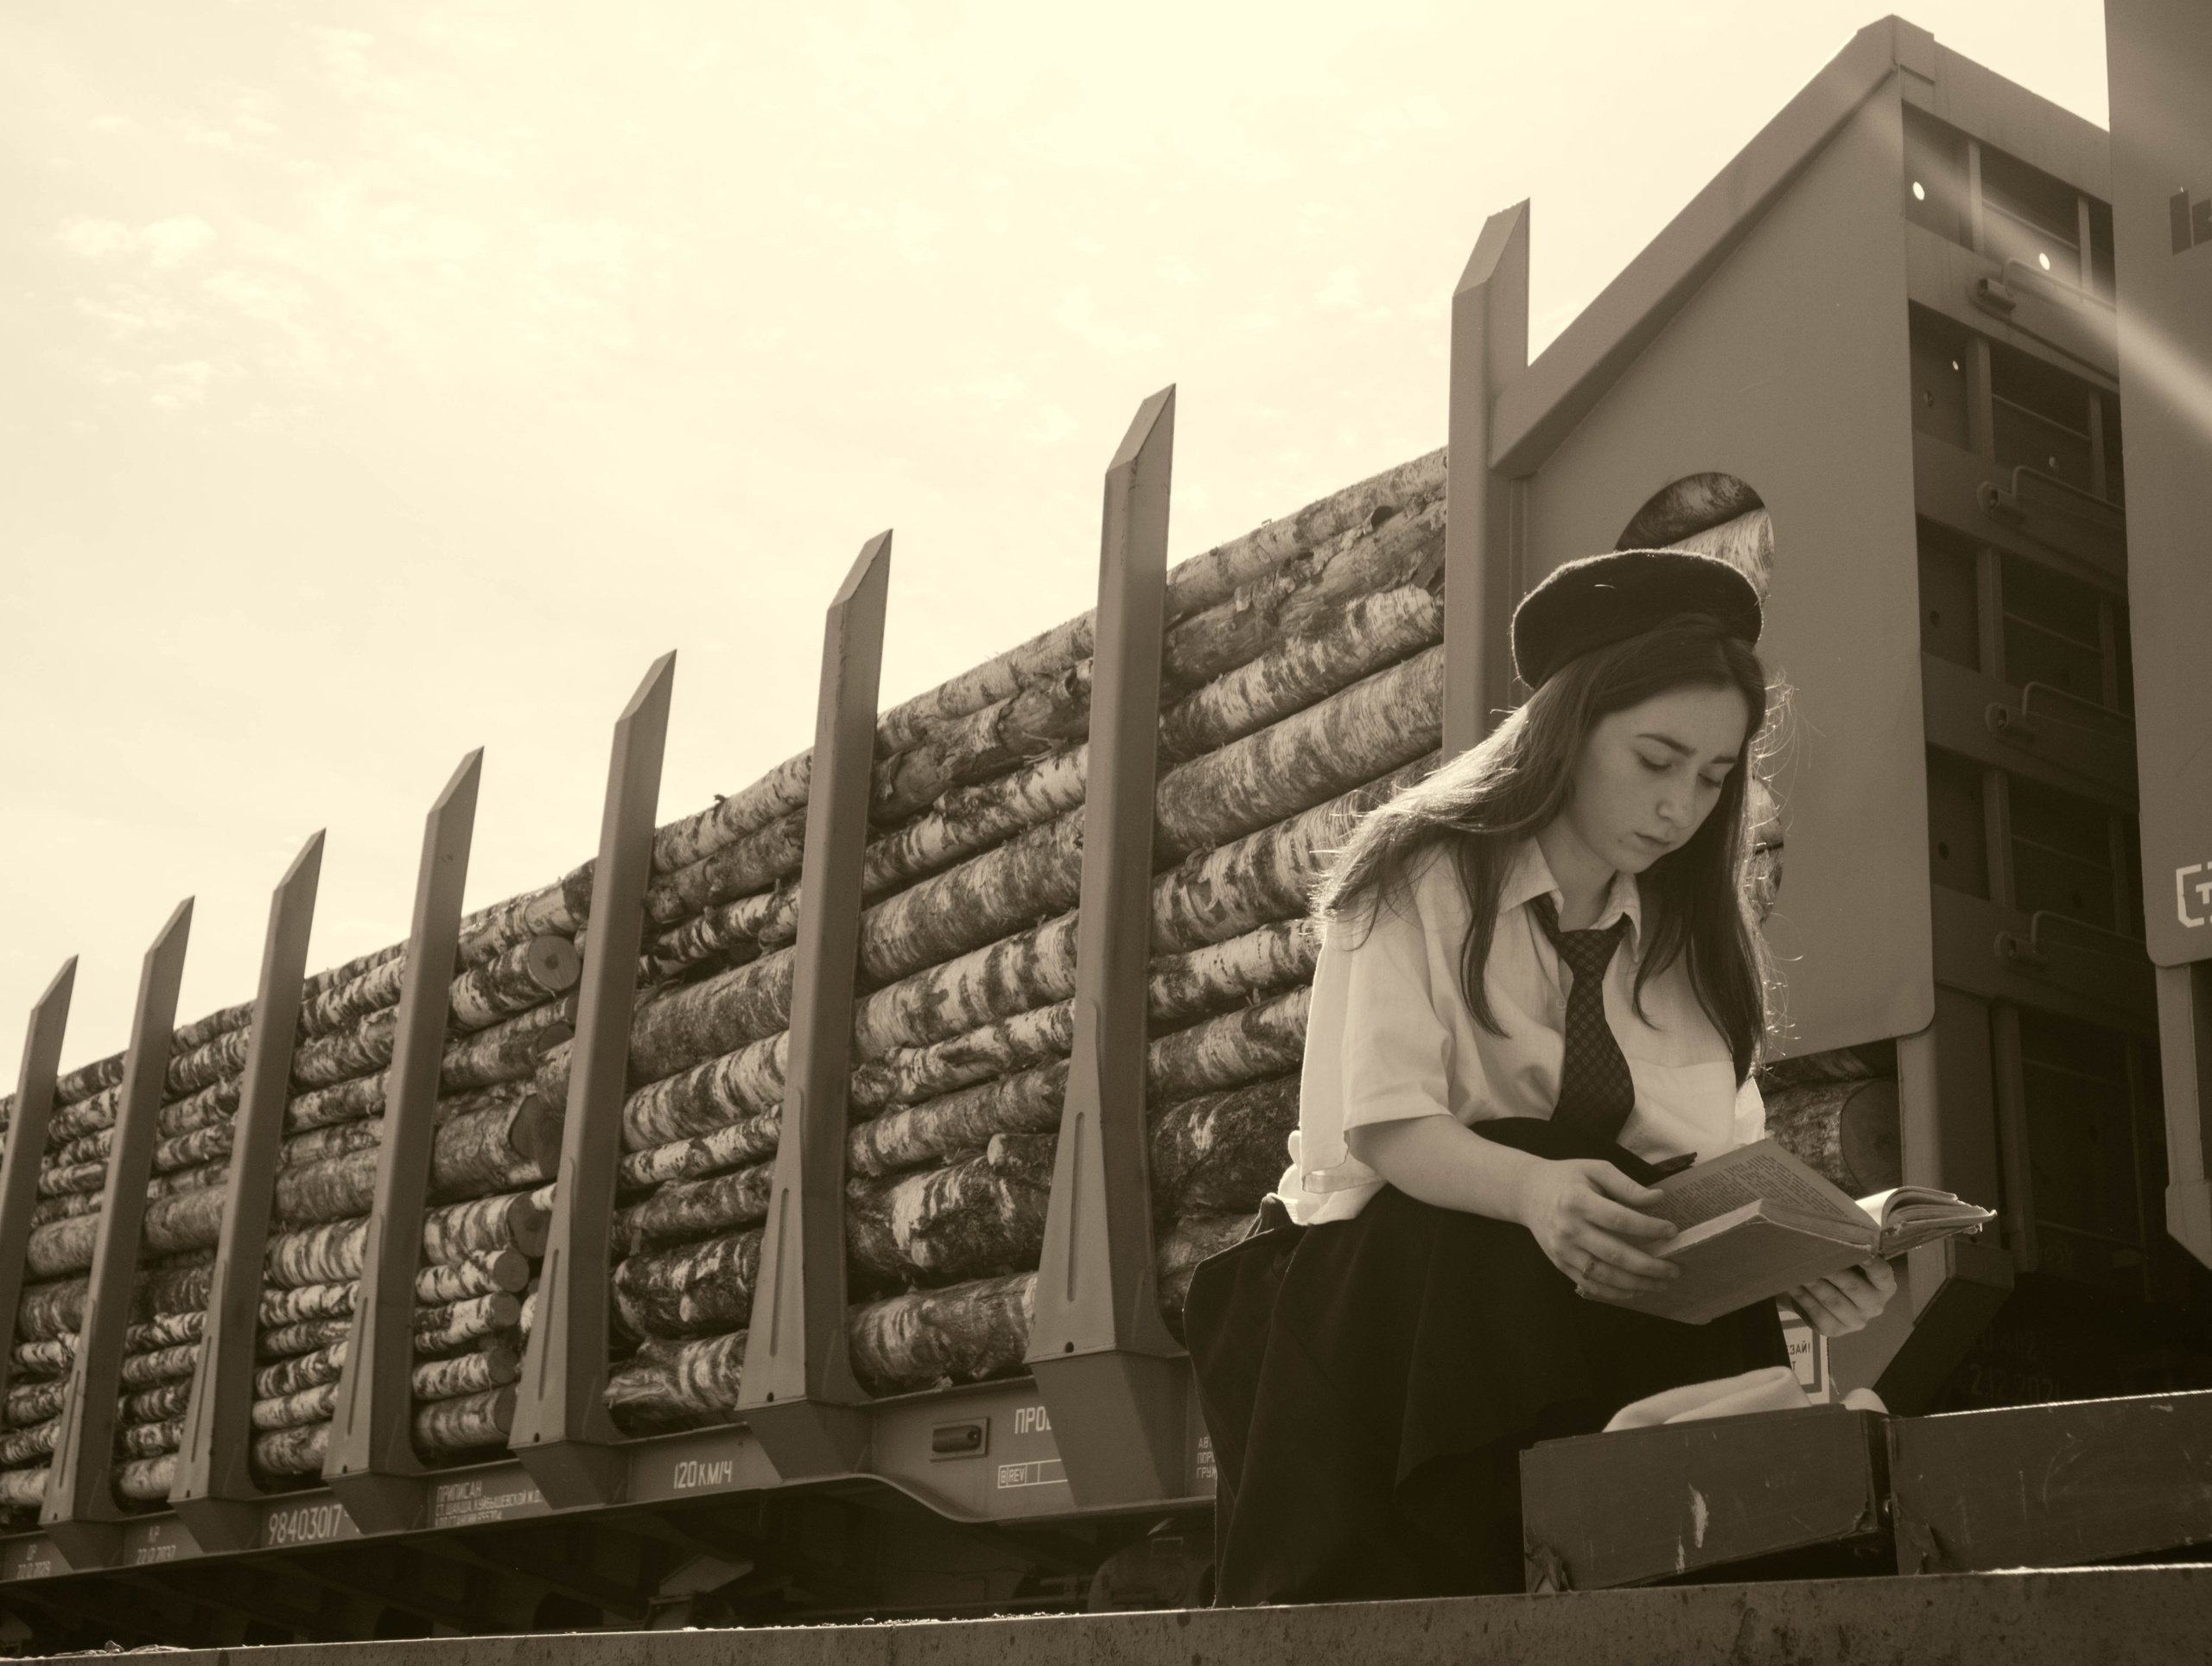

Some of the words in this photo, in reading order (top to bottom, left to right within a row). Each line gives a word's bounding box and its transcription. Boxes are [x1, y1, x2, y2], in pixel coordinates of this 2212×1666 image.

[1787, 1341, 1811, 1357] ЗАЙ!
[673, 1460, 697, 1490] 120
[1008, 1468, 1026, 1483] REV
[268, 1504, 343, 1546] 98403017
